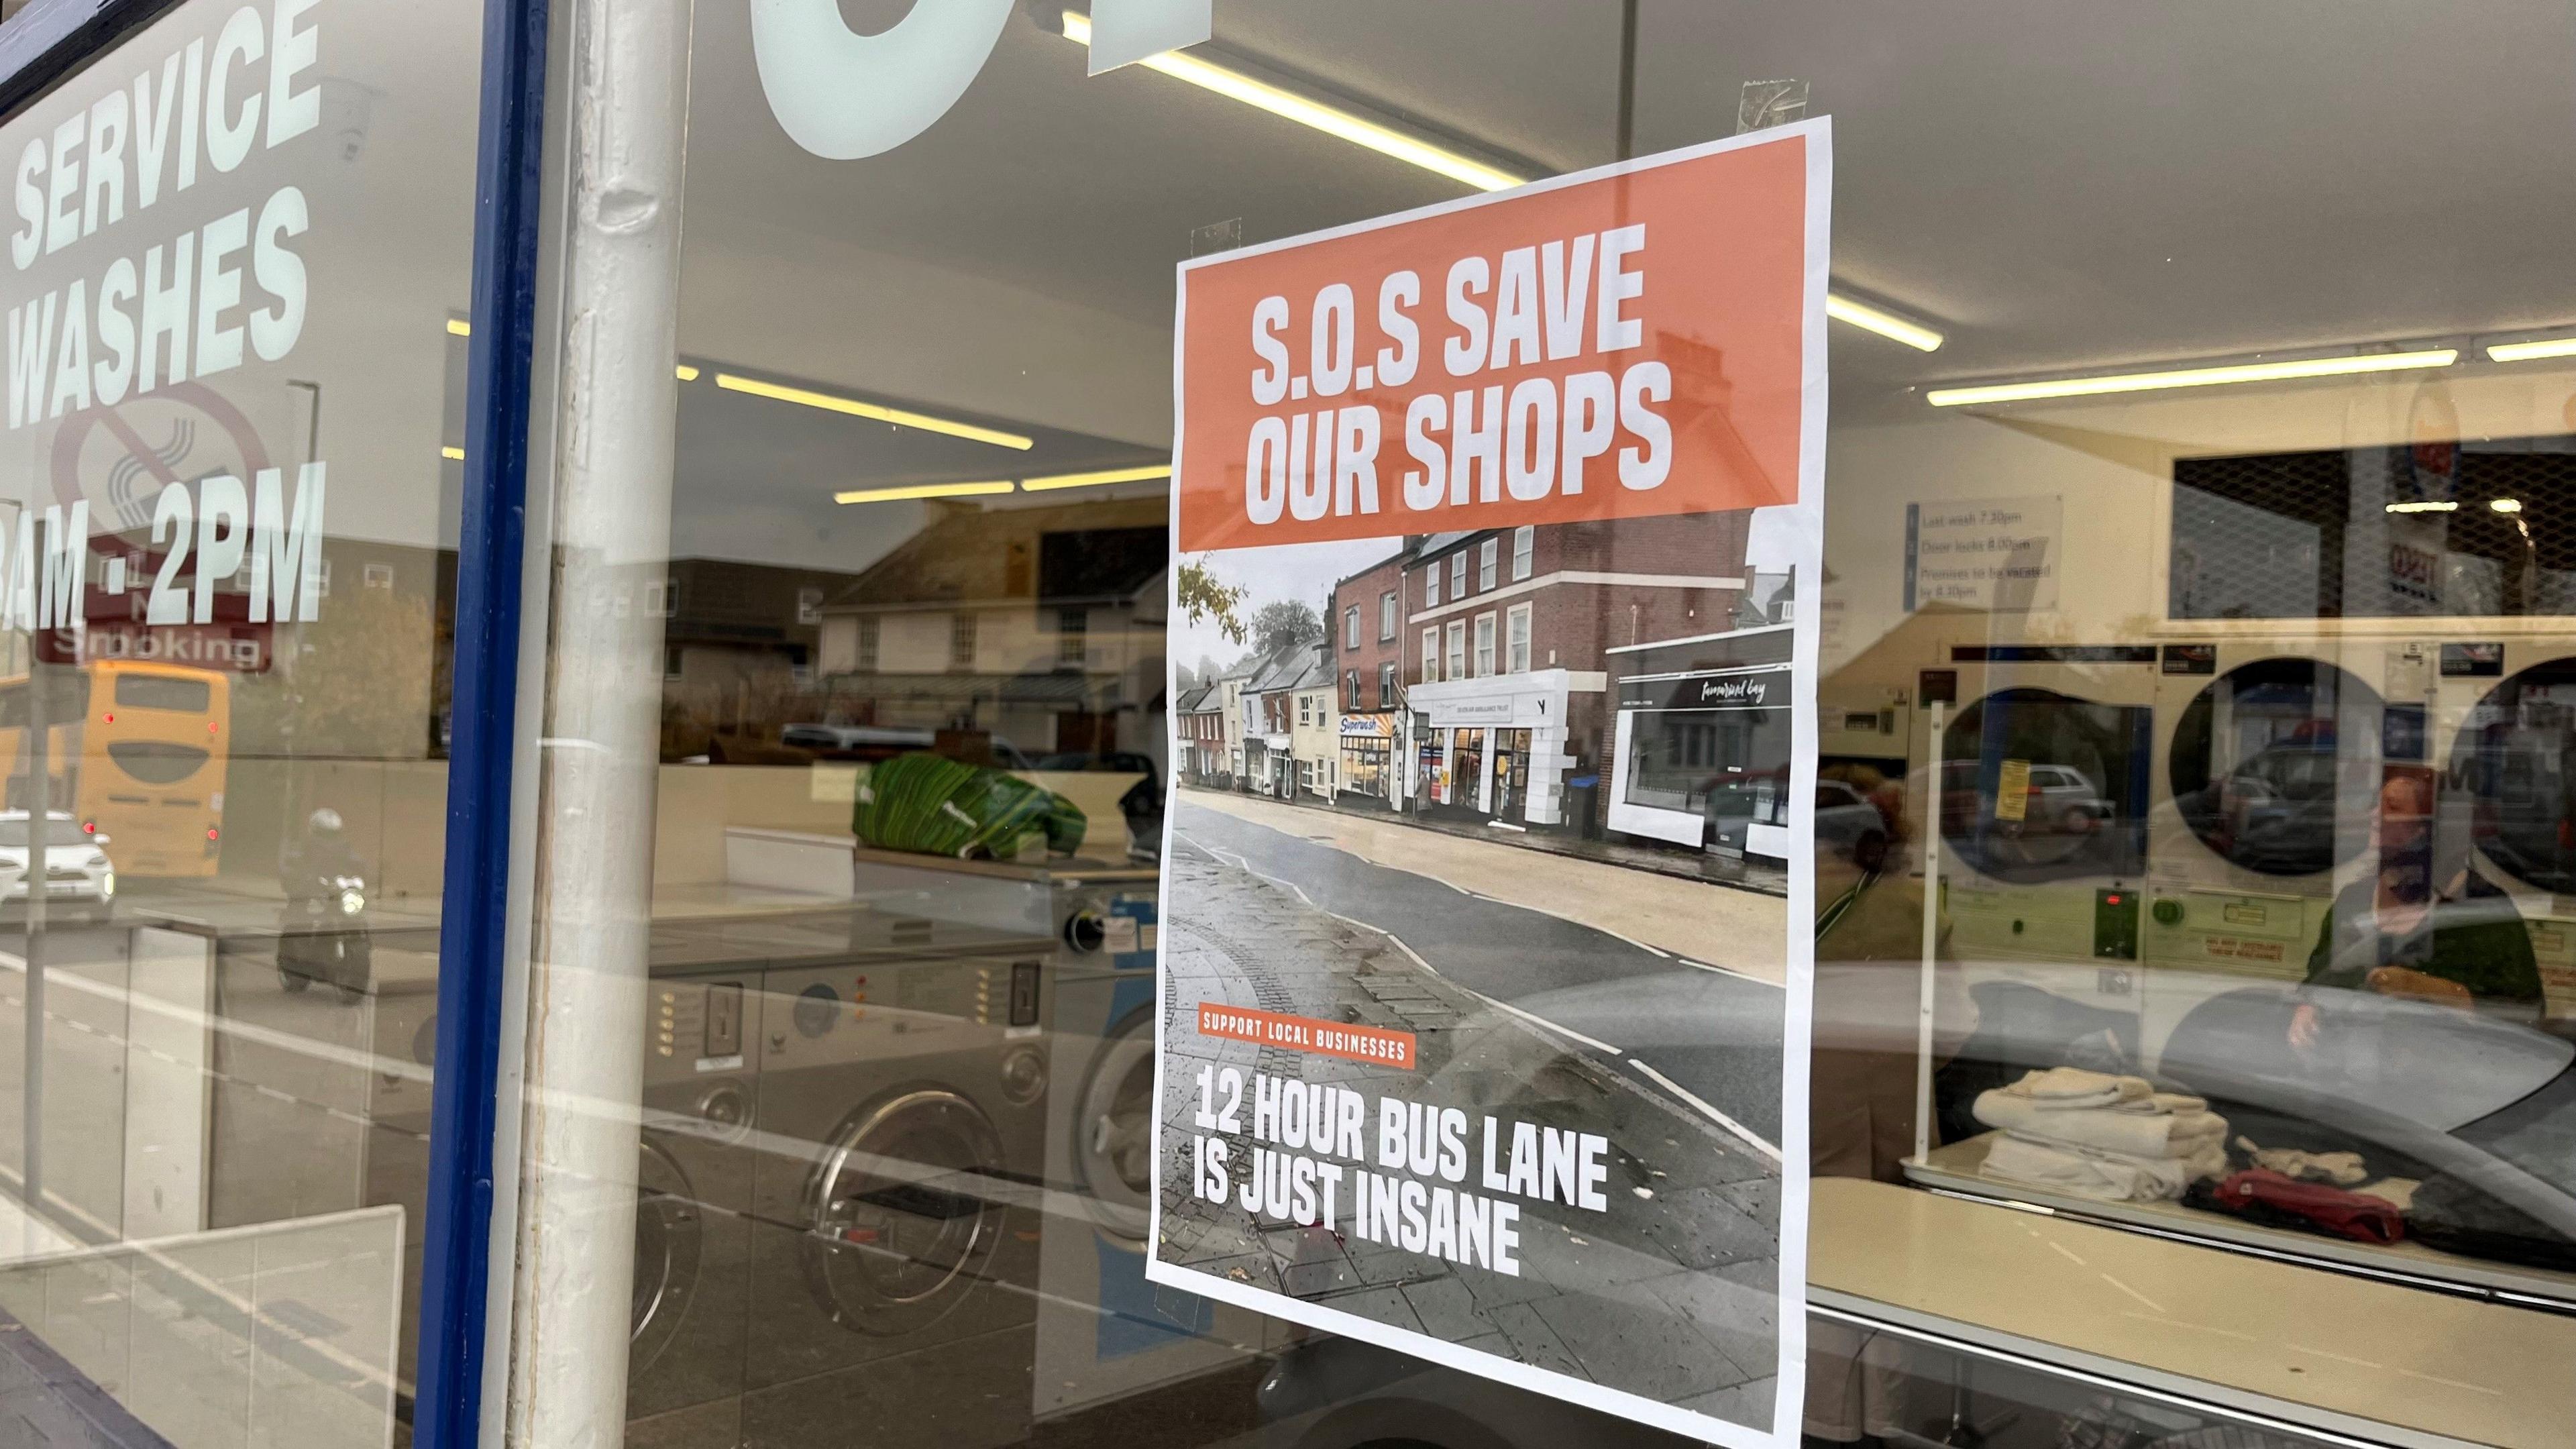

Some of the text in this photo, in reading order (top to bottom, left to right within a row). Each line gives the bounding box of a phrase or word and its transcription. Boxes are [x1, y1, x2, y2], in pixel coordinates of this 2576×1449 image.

[11, 0, 321, 271] SERVICE
[7, 185, 309, 429] WASHES
[1251, 223, 1646, 406] S.O.S SAVE
[1246, 362, 1672, 525] OUR SHOPS
[0, 498, 89, 634] AM
[146, 461, 327, 626] 2PM
[54, 629, 260, 667] Smoking
[1340, 717, 1377, 733] Superwash
[1203, 1011, 1406, 1061] SUPPORT LOCAL BUSINESSES
[1194, 1134, 1520, 1277] IS JUST INSANE
[1195, 1065, 1608, 1213] 12 HOUR BUS LANE
